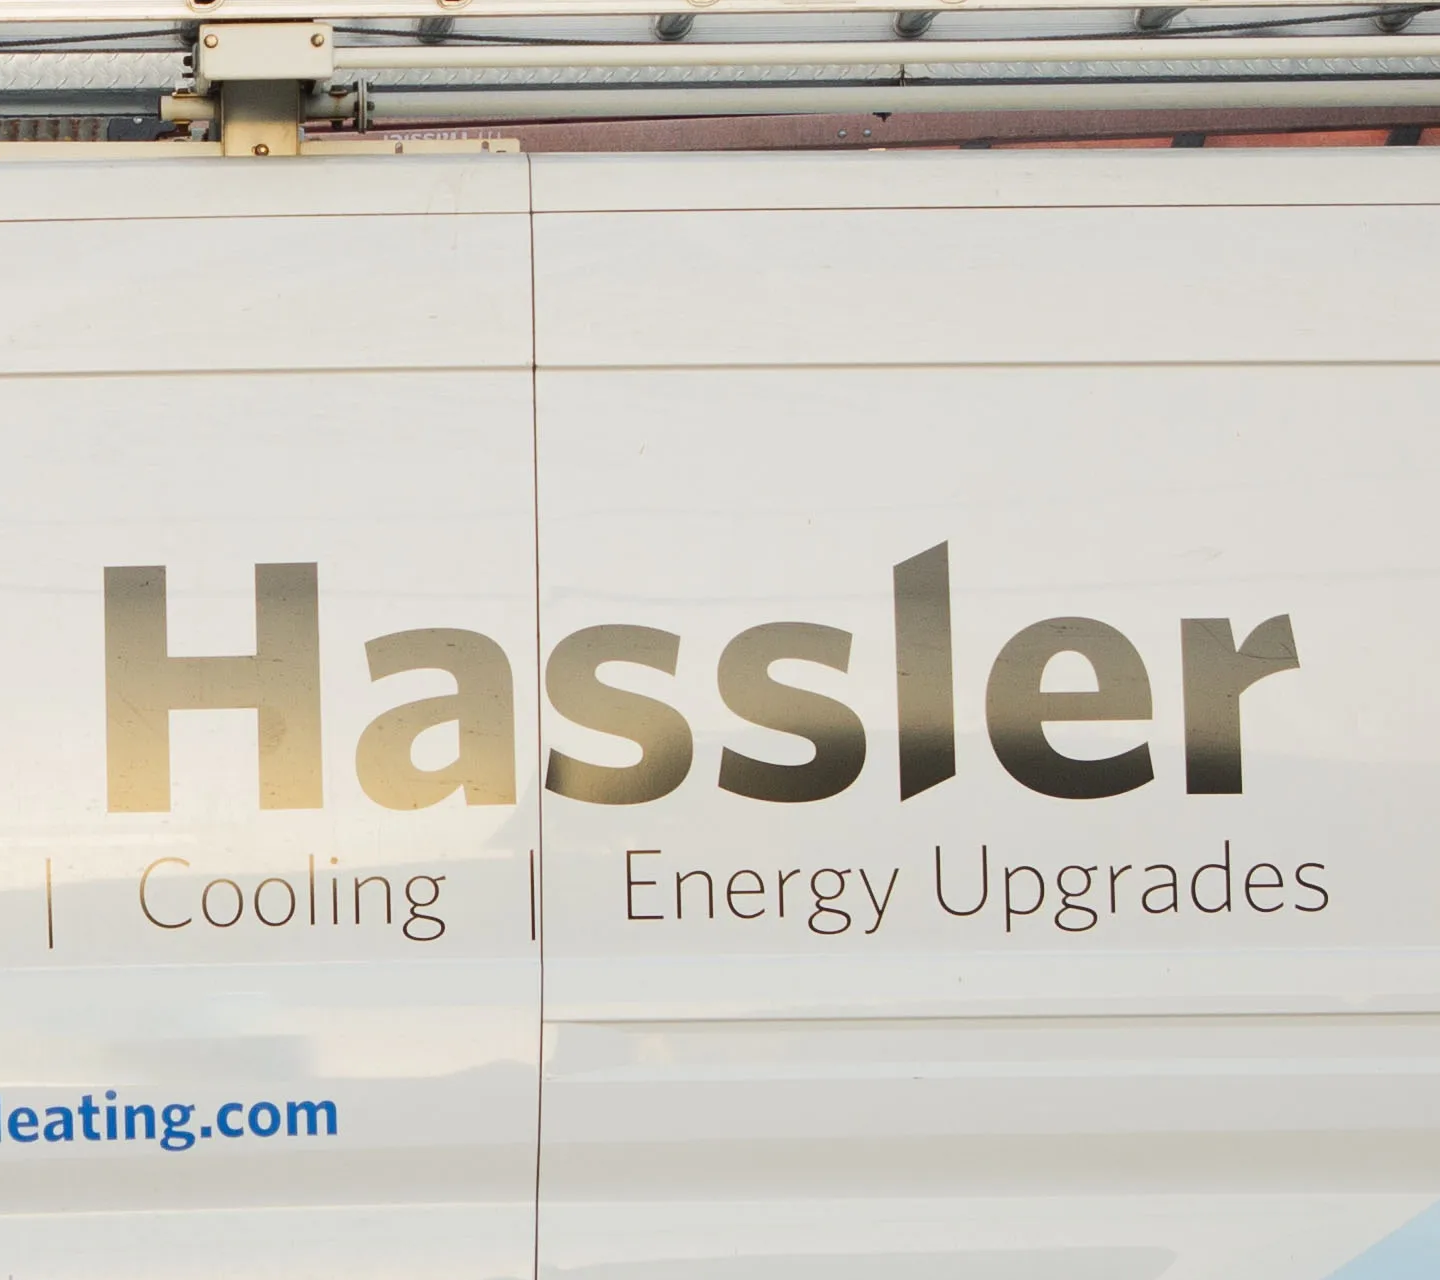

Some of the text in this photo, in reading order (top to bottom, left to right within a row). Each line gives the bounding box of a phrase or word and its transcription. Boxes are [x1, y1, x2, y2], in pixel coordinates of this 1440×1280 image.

[102, 539, 1300, 813] Hassler
[137, 848, 446, 941] Cooling
[624, 846, 913, 936] Energy
[935, 839, 1330, 930] Upgrades
